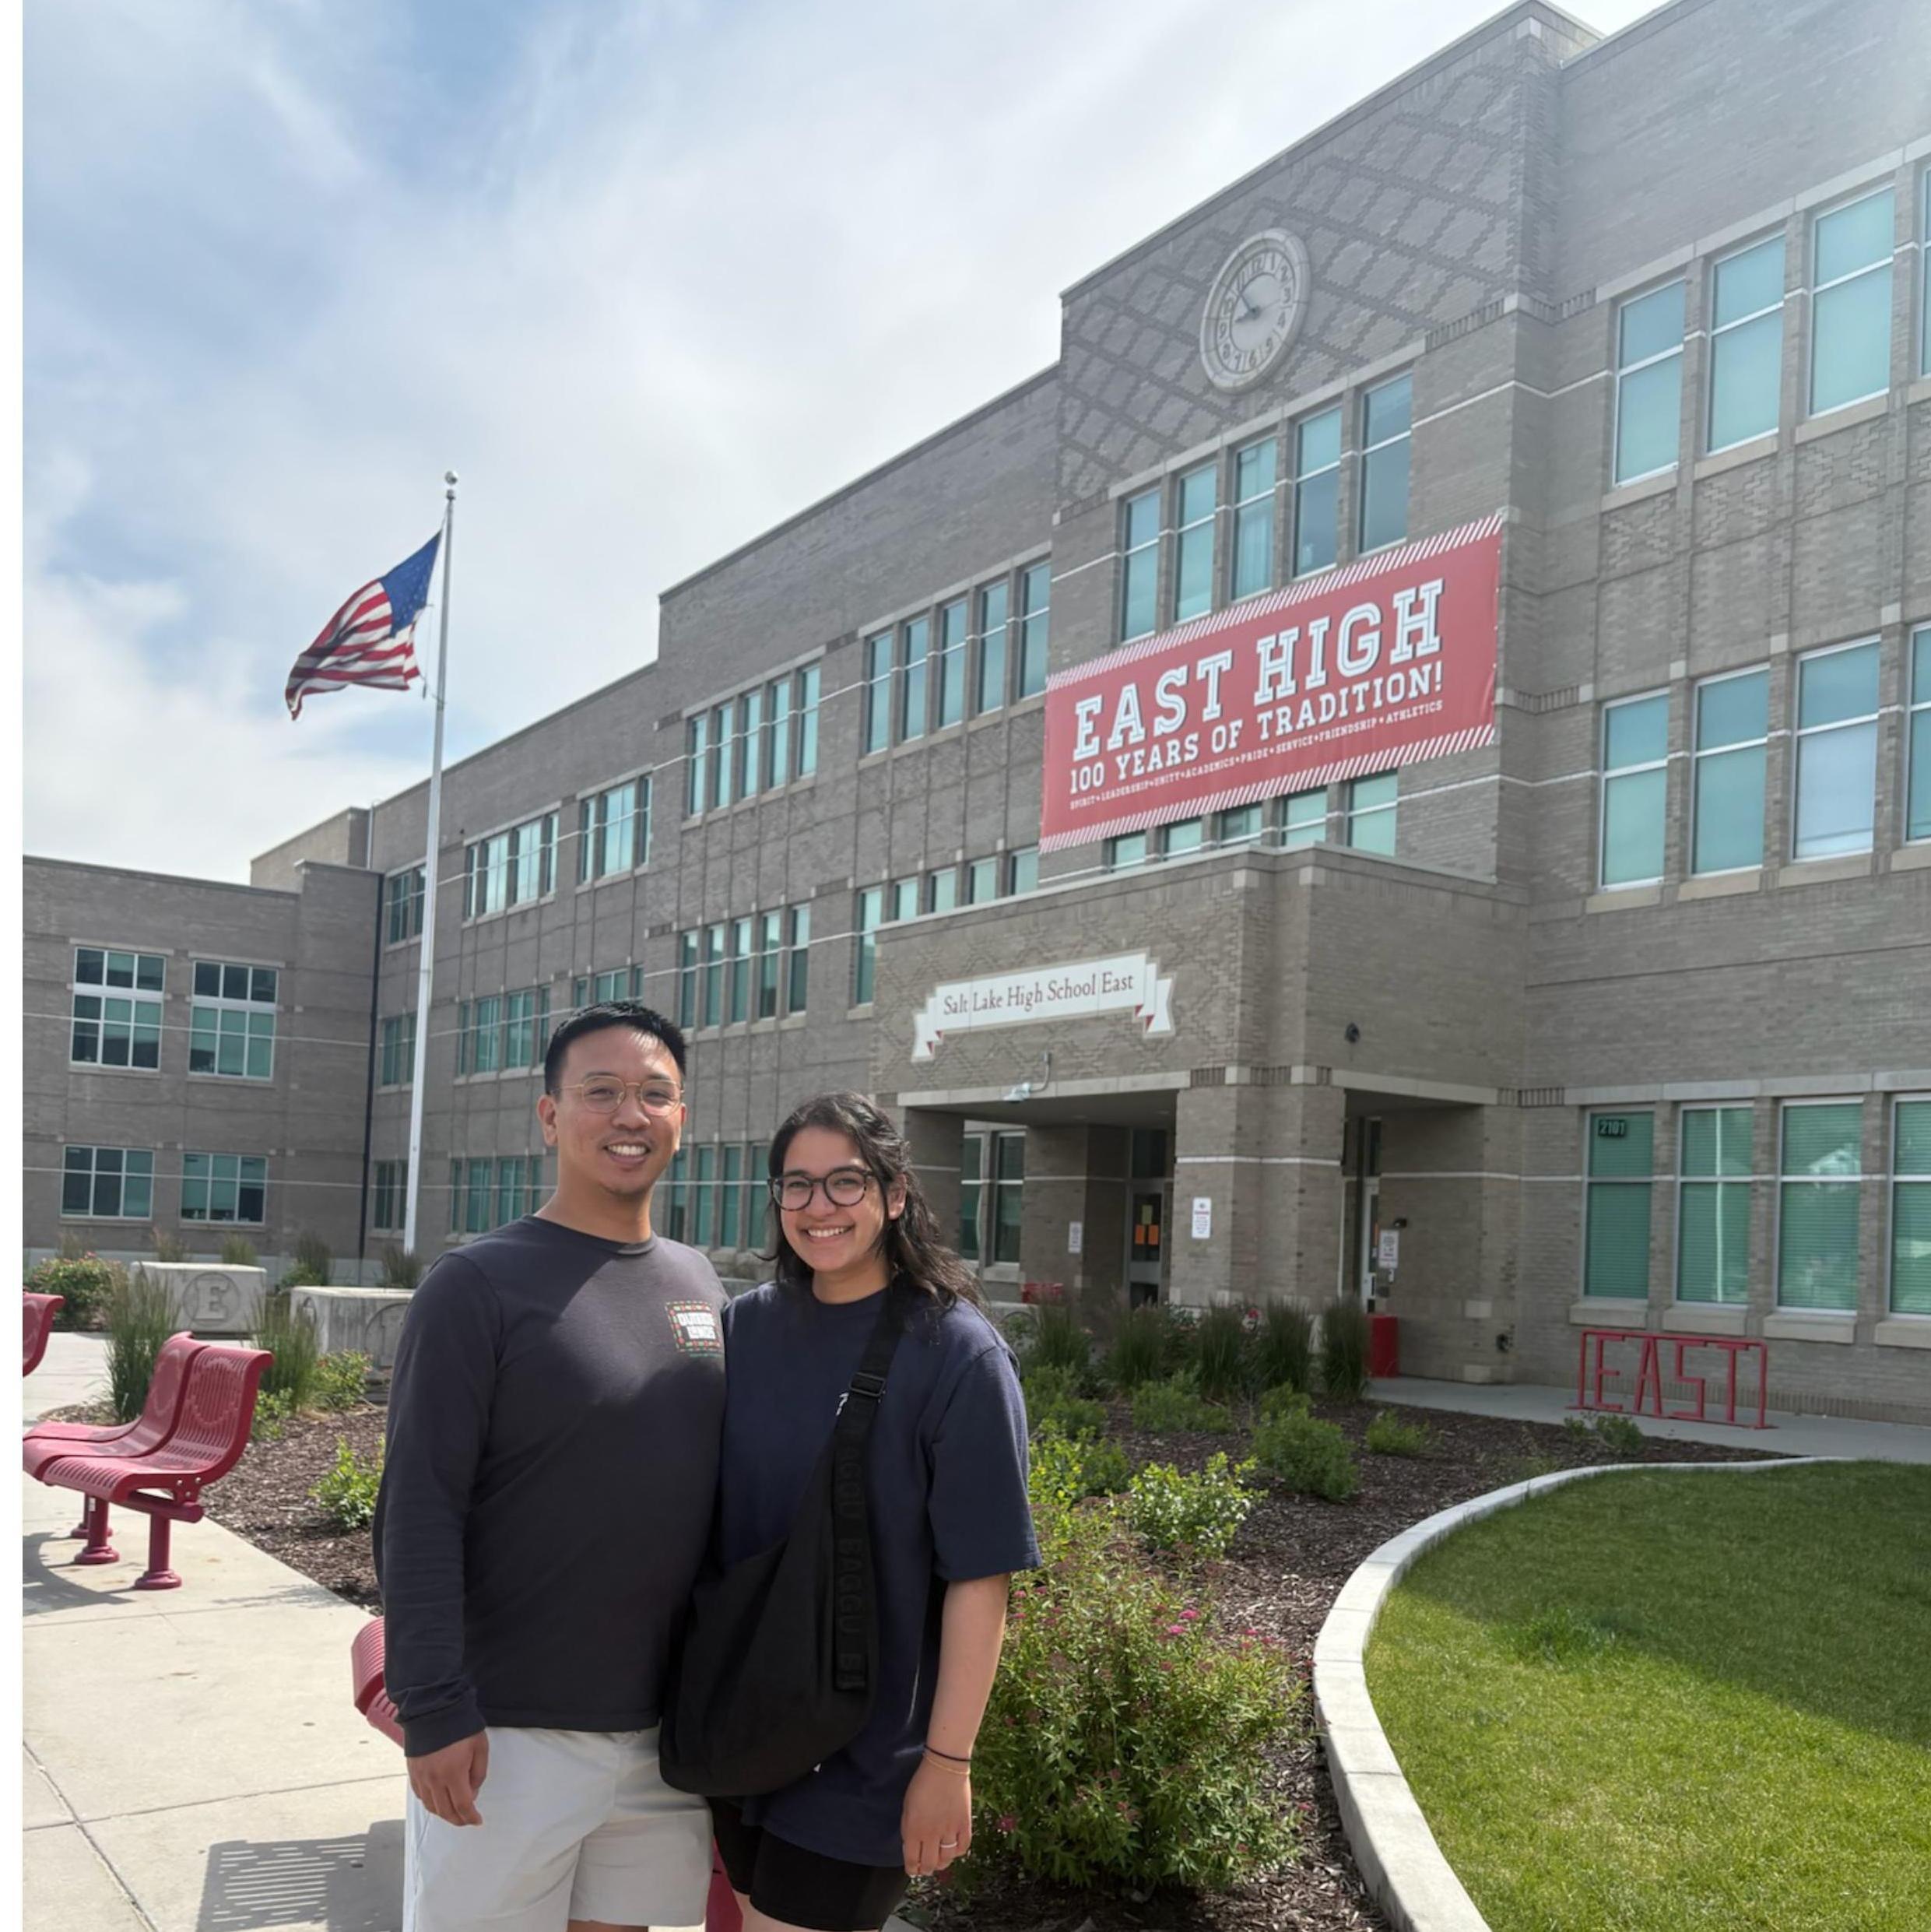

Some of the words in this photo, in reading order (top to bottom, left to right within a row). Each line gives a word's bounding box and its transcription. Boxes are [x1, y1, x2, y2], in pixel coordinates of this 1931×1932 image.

[1284, 287, 1292, 304] 3
[1219, 322, 1227, 339] 9
[1277, 311, 1286, 328] 4
[1223, 343, 1231, 359] 8
[1234, 353, 1243, 371] 7
[1248, 349, 1257, 367] 6
[1073, 649, 1232, 761] EAST
[1254, 578, 1444, 707] HIGH
[1070, 761, 1104, 795] 100
[1115, 732, 1199, 781] YEARS
[1211, 719, 1243, 753] OF
[1257, 660, 1443, 741] TRADITION!
[1070, 796, 1095, 810] SPIRIT
[1101, 780, 1149, 801] LEADERSHIP
[1154, 771, 1181, 786] UNITY
[1185, 757, 1235, 778] ACADEMICS
[1241, 747, 1269, 763] PRIDE
[1276, 735, 1313, 753] SERVICE
[1319, 718, 1377, 743] FRIENDSHIP
[1385, 700, 1444, 725] ATHLETICS
[943, 992, 968, 1016] Salt
[973, 989, 1003, 1011] Lake
[1007, 982, 1043, 1012] High
[1048, 973, 1096, 1001] School
[1102, 971, 1134, 994] East
[1599, 1120, 1625, 1135] 2101
[192, 1279, 231, 1322] E
[1594, 1334, 1750, 1424] EAST
[838, 1537, 864, 1634] BAGGU
